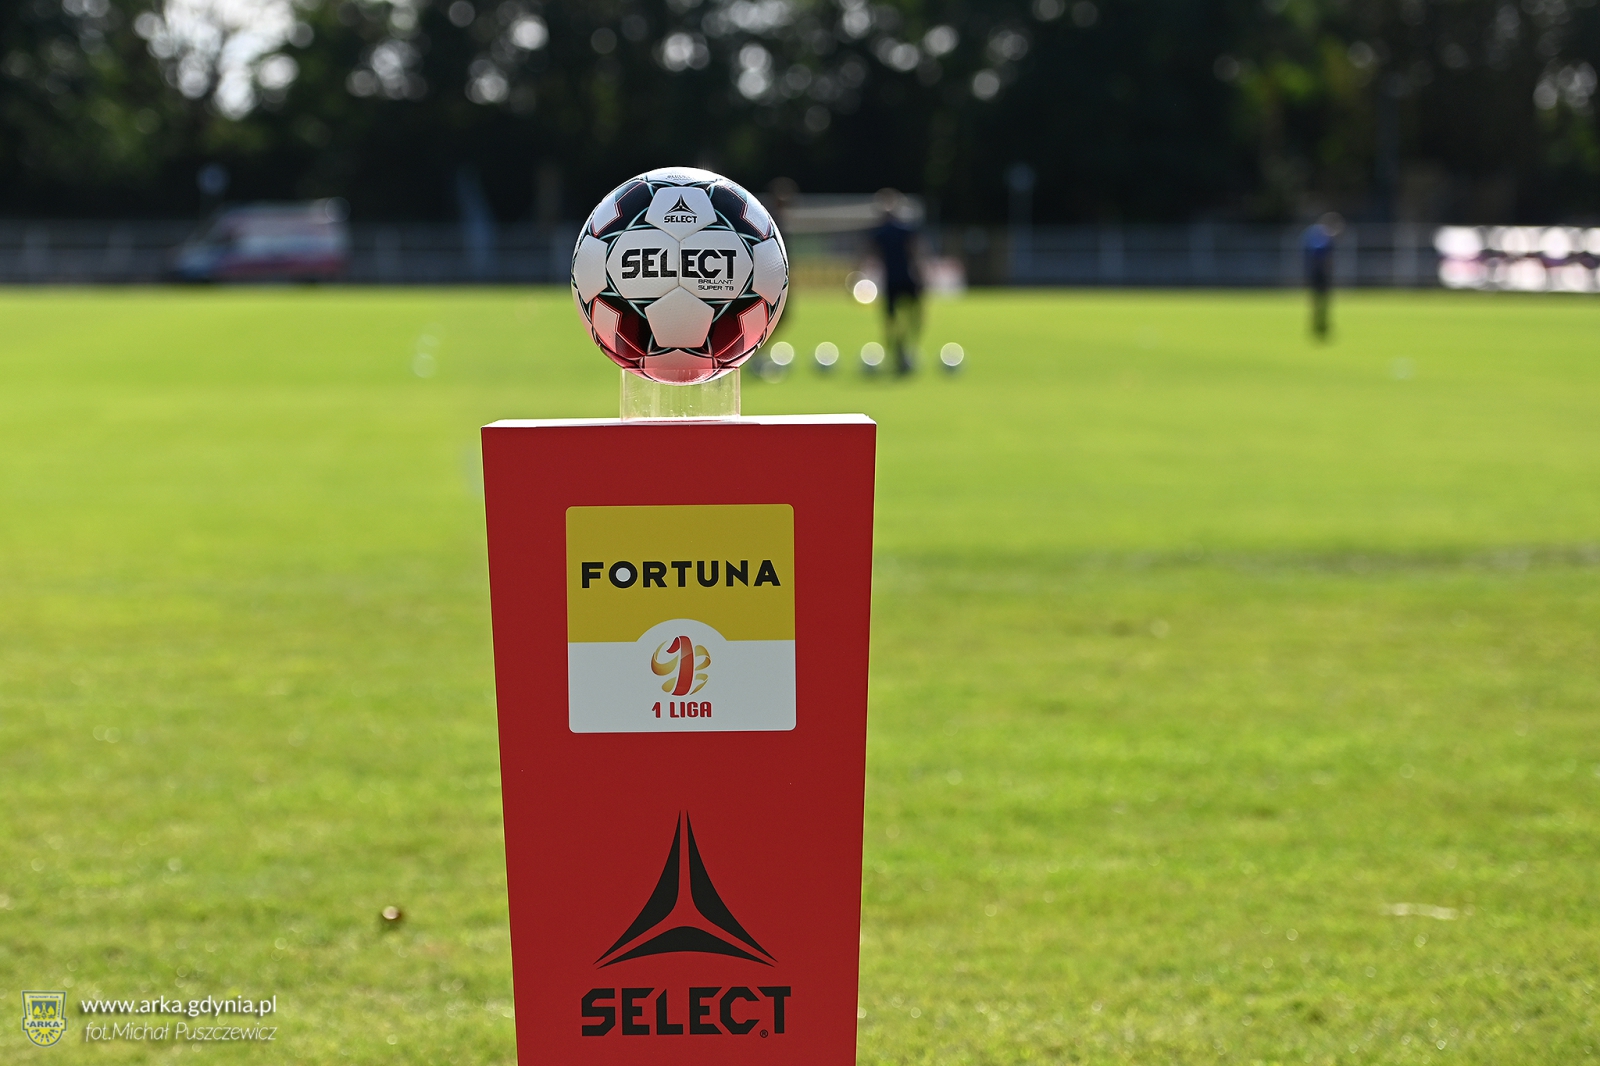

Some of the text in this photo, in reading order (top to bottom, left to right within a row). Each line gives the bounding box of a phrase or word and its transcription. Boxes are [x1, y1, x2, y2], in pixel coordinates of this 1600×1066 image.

[664, 215, 697, 223] SELECT
[621, 248, 736, 279] SELECT
[581, 560, 781, 588] FORTUNA
[652, 701, 712, 718] 1 LIGA
[581, 986, 791, 1036] SELECT
